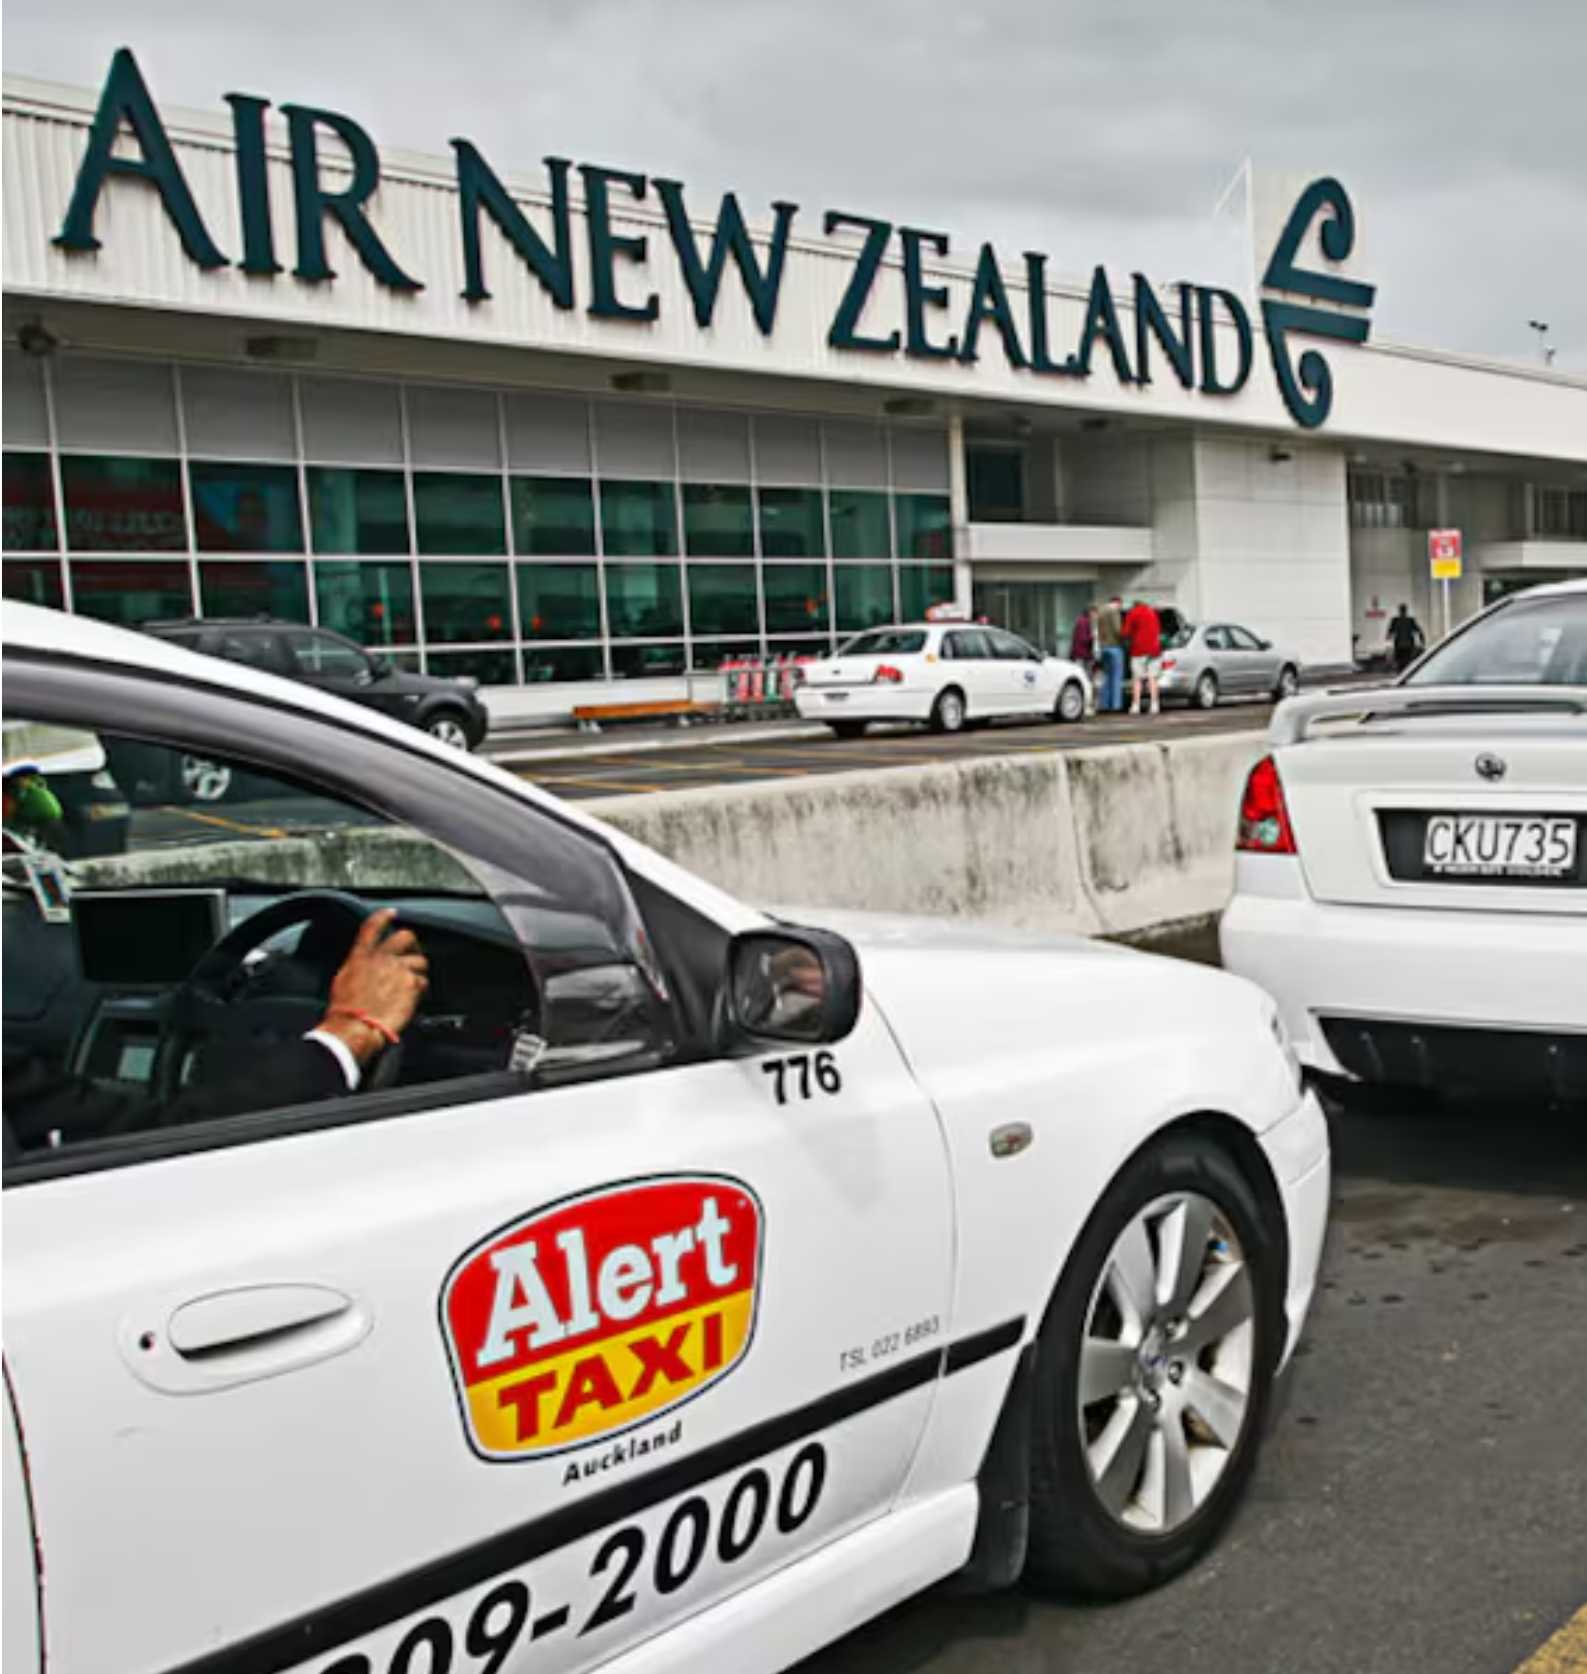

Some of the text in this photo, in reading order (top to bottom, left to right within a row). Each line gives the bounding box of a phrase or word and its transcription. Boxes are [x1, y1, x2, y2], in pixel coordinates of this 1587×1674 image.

[51, 47, 1253, 395] AIR NEW ZEALAND
[1430, 820, 1571, 864] CKU735
[761, 1051, 841, 1105] 776
[476, 1196, 738, 1368] Alert
[498, 1312, 723, 1443] TAXI
[562, 1420, 683, 1487] Auckland
[316, 1442, 827, 1674] 09-2000
